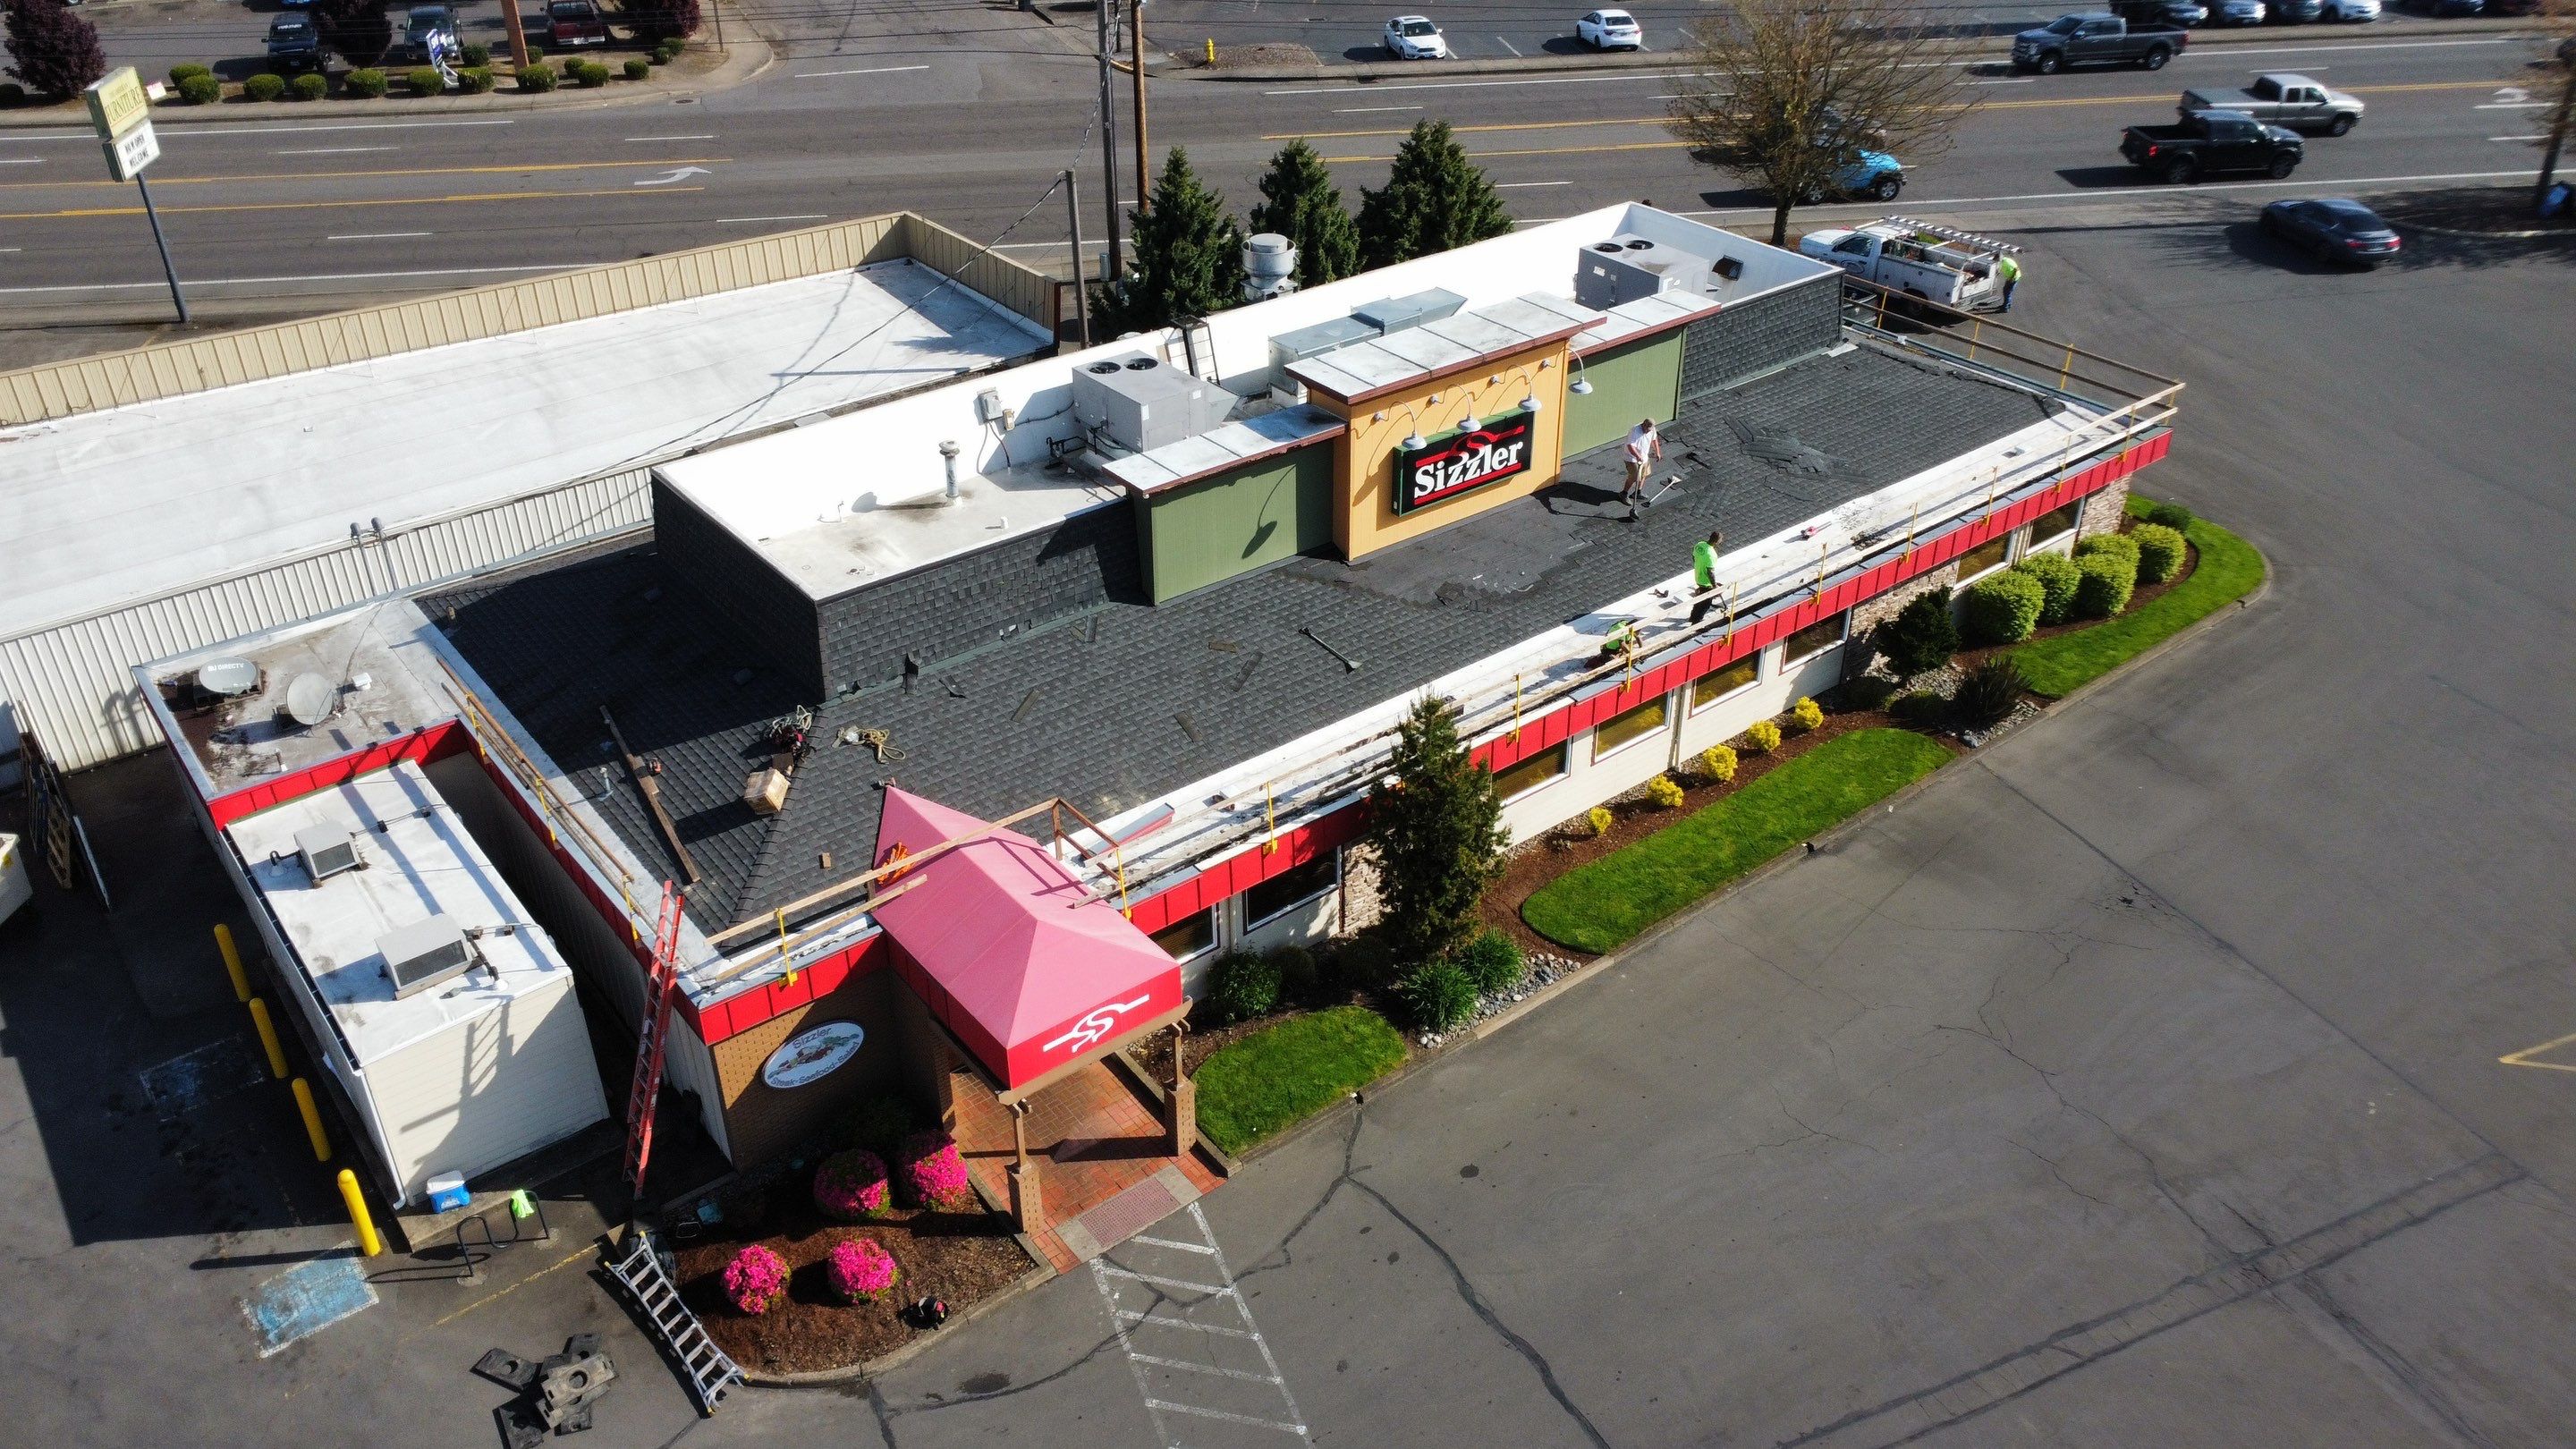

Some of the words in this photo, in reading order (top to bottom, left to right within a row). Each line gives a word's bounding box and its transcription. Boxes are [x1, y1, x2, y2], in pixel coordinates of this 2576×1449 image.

[105, 86, 143, 124] FURNITURE
[129, 148, 149, 168] WELCOME
[1414, 441, 1523, 499] Sizzler
[217, 663, 244, 671] DIRECTV
[792, 1028, 832, 1049] Sizzler
